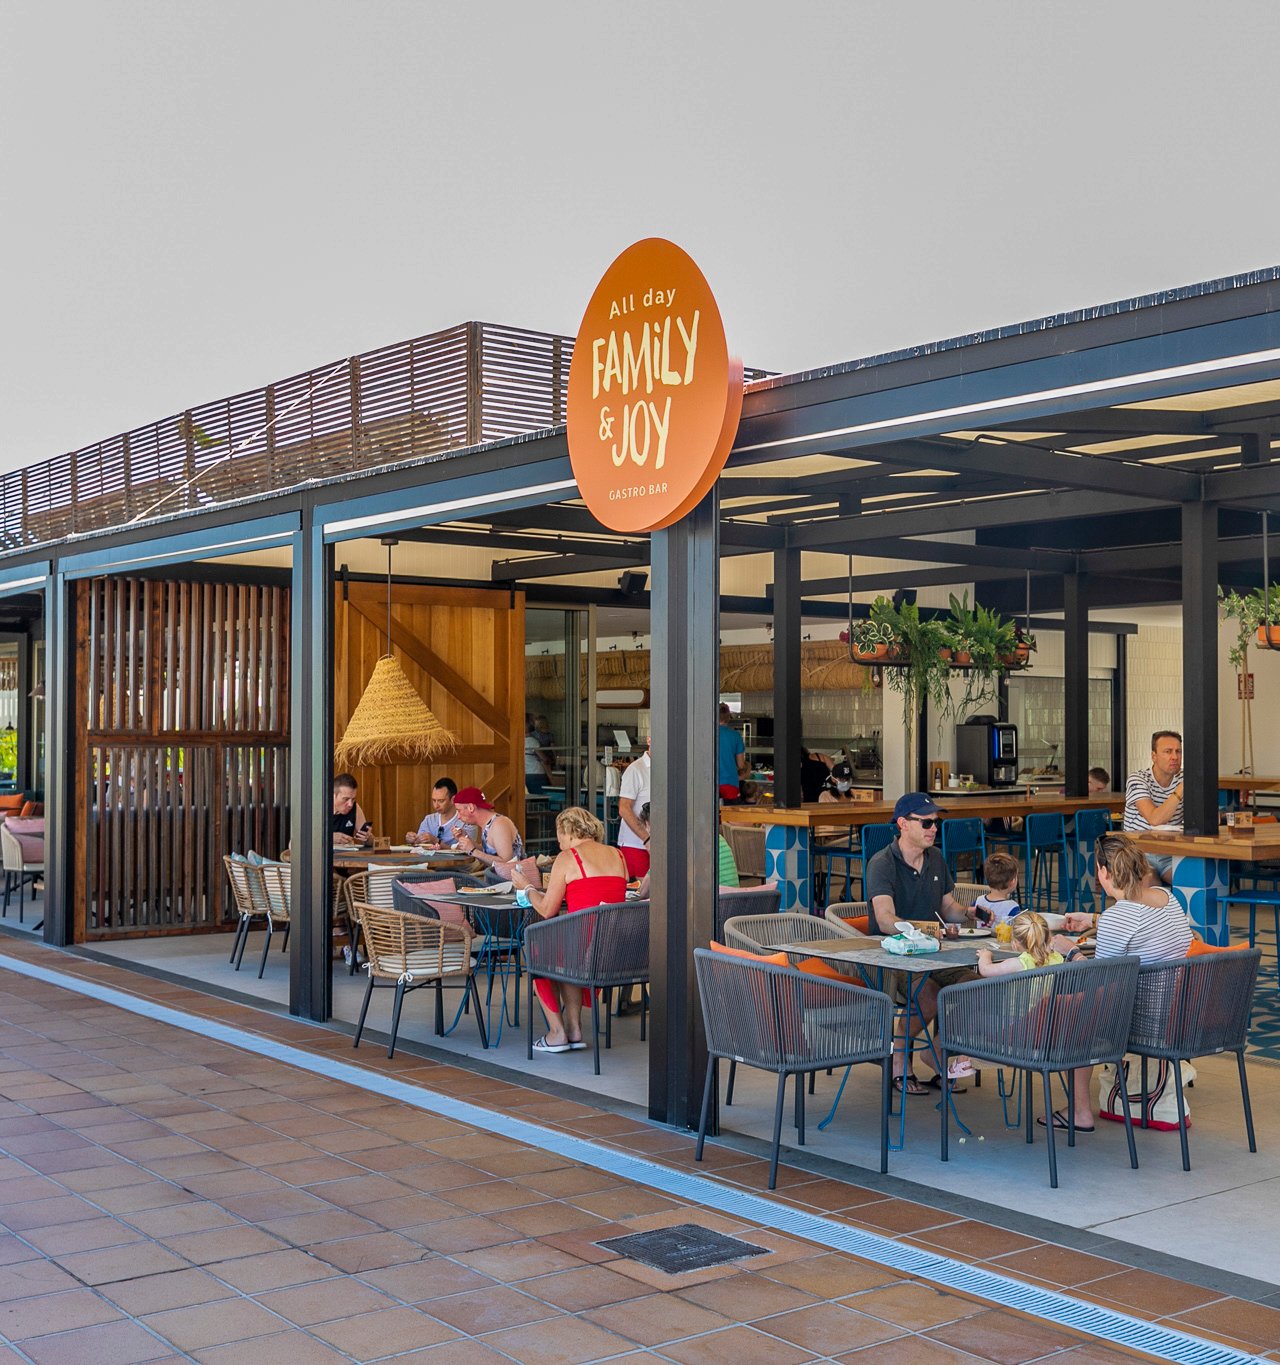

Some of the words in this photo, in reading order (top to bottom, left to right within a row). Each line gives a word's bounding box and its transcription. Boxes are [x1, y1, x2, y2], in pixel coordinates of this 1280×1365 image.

[609, 293, 635, 320] All
[643, 287, 676, 308] day
[599, 406, 615, 441] &
[612, 396, 672, 470] JOY
[609, 485, 646, 501] GASTRO
[648, 482, 668, 495] BAR
